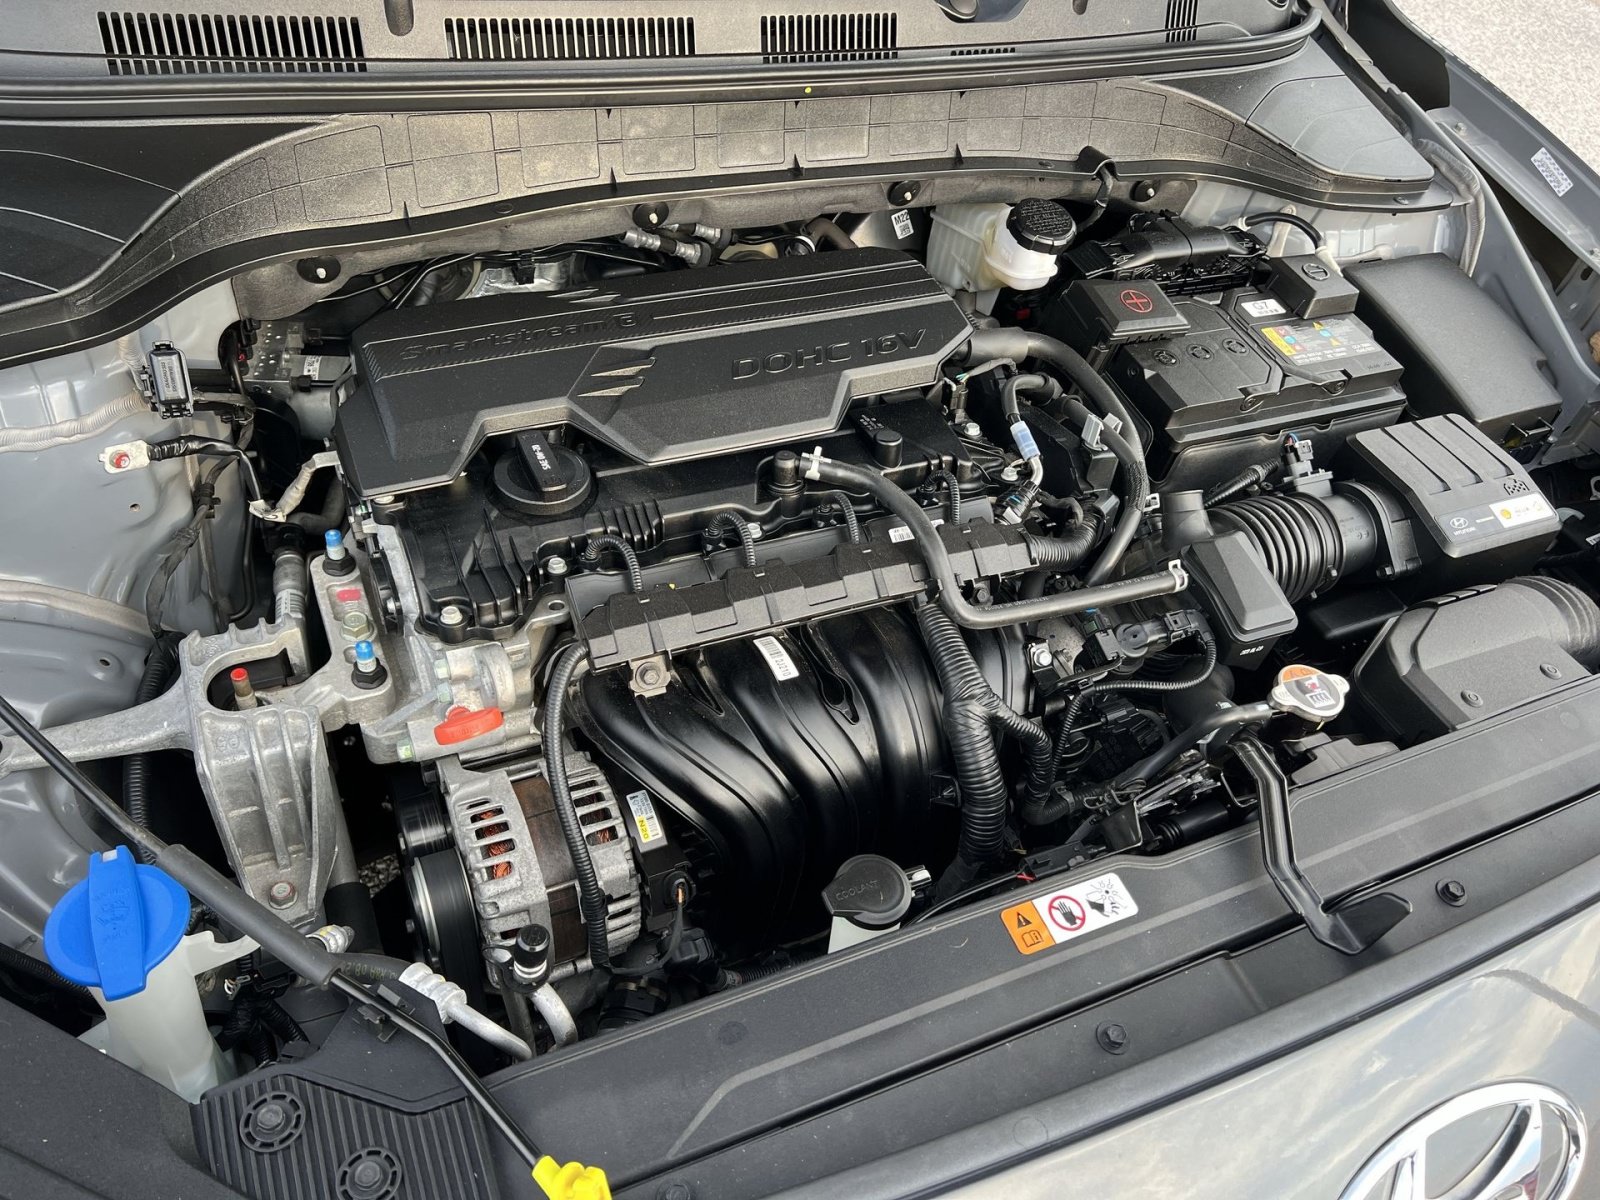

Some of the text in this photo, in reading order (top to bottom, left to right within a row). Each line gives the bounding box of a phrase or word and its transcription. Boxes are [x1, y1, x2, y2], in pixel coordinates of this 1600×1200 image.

[894, 211, 910, 225] M22
[1252, 301, 1269, 310] G7
[399, 320, 606, 361] Smartstream
[731, 328, 926, 380] DOHC 16V
[538, 459, 551, 470] SAE
[639, 819, 650, 840] N20
